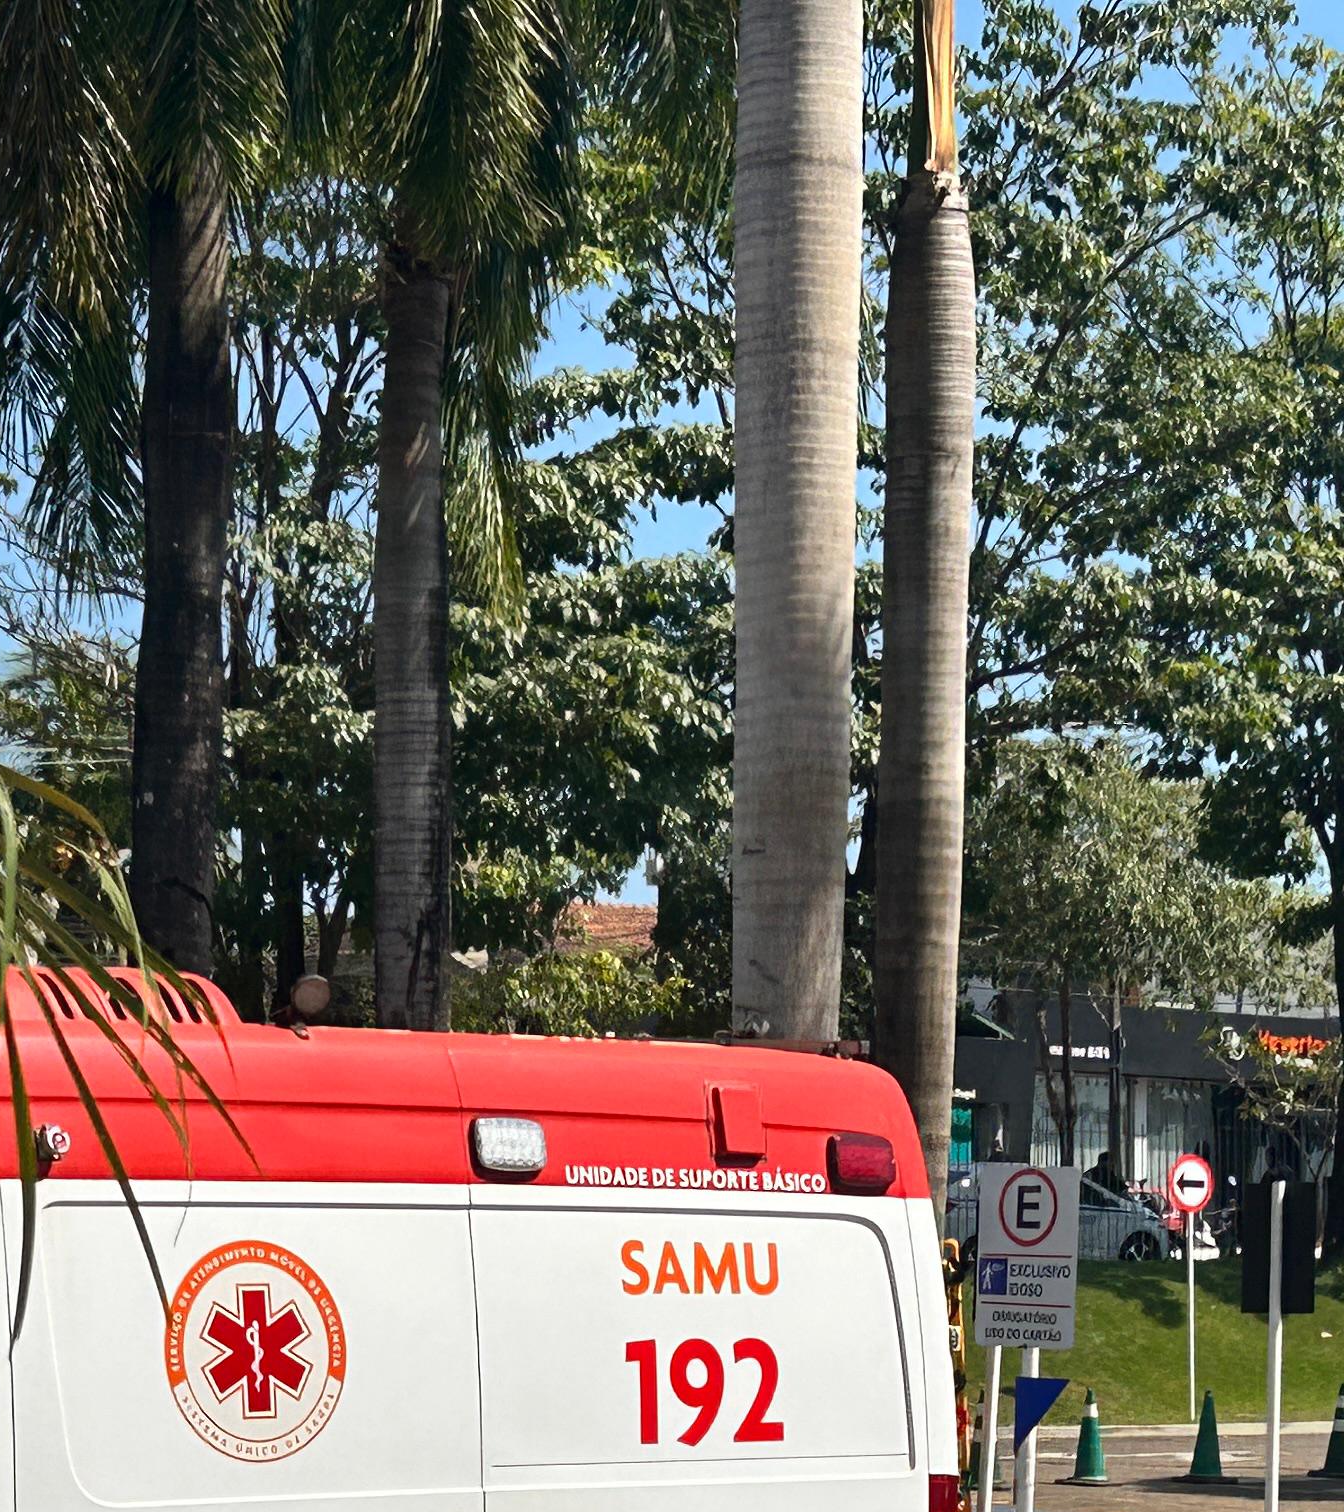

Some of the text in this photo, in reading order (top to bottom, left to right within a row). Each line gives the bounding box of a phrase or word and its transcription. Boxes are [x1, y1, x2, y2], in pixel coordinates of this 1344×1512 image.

[565, 1165, 826, 1193] UNIDADE DE SUPORTE BÁSICO
[1016, 1185, 1042, 1229] E
[621, 1240, 779, 1295] SAMU
[1009, 1264, 1071, 1279] EXCLUSIVO
[1009, 1283, 1043, 1297] IDOSO
[625, 1338, 784, 1446] 192
